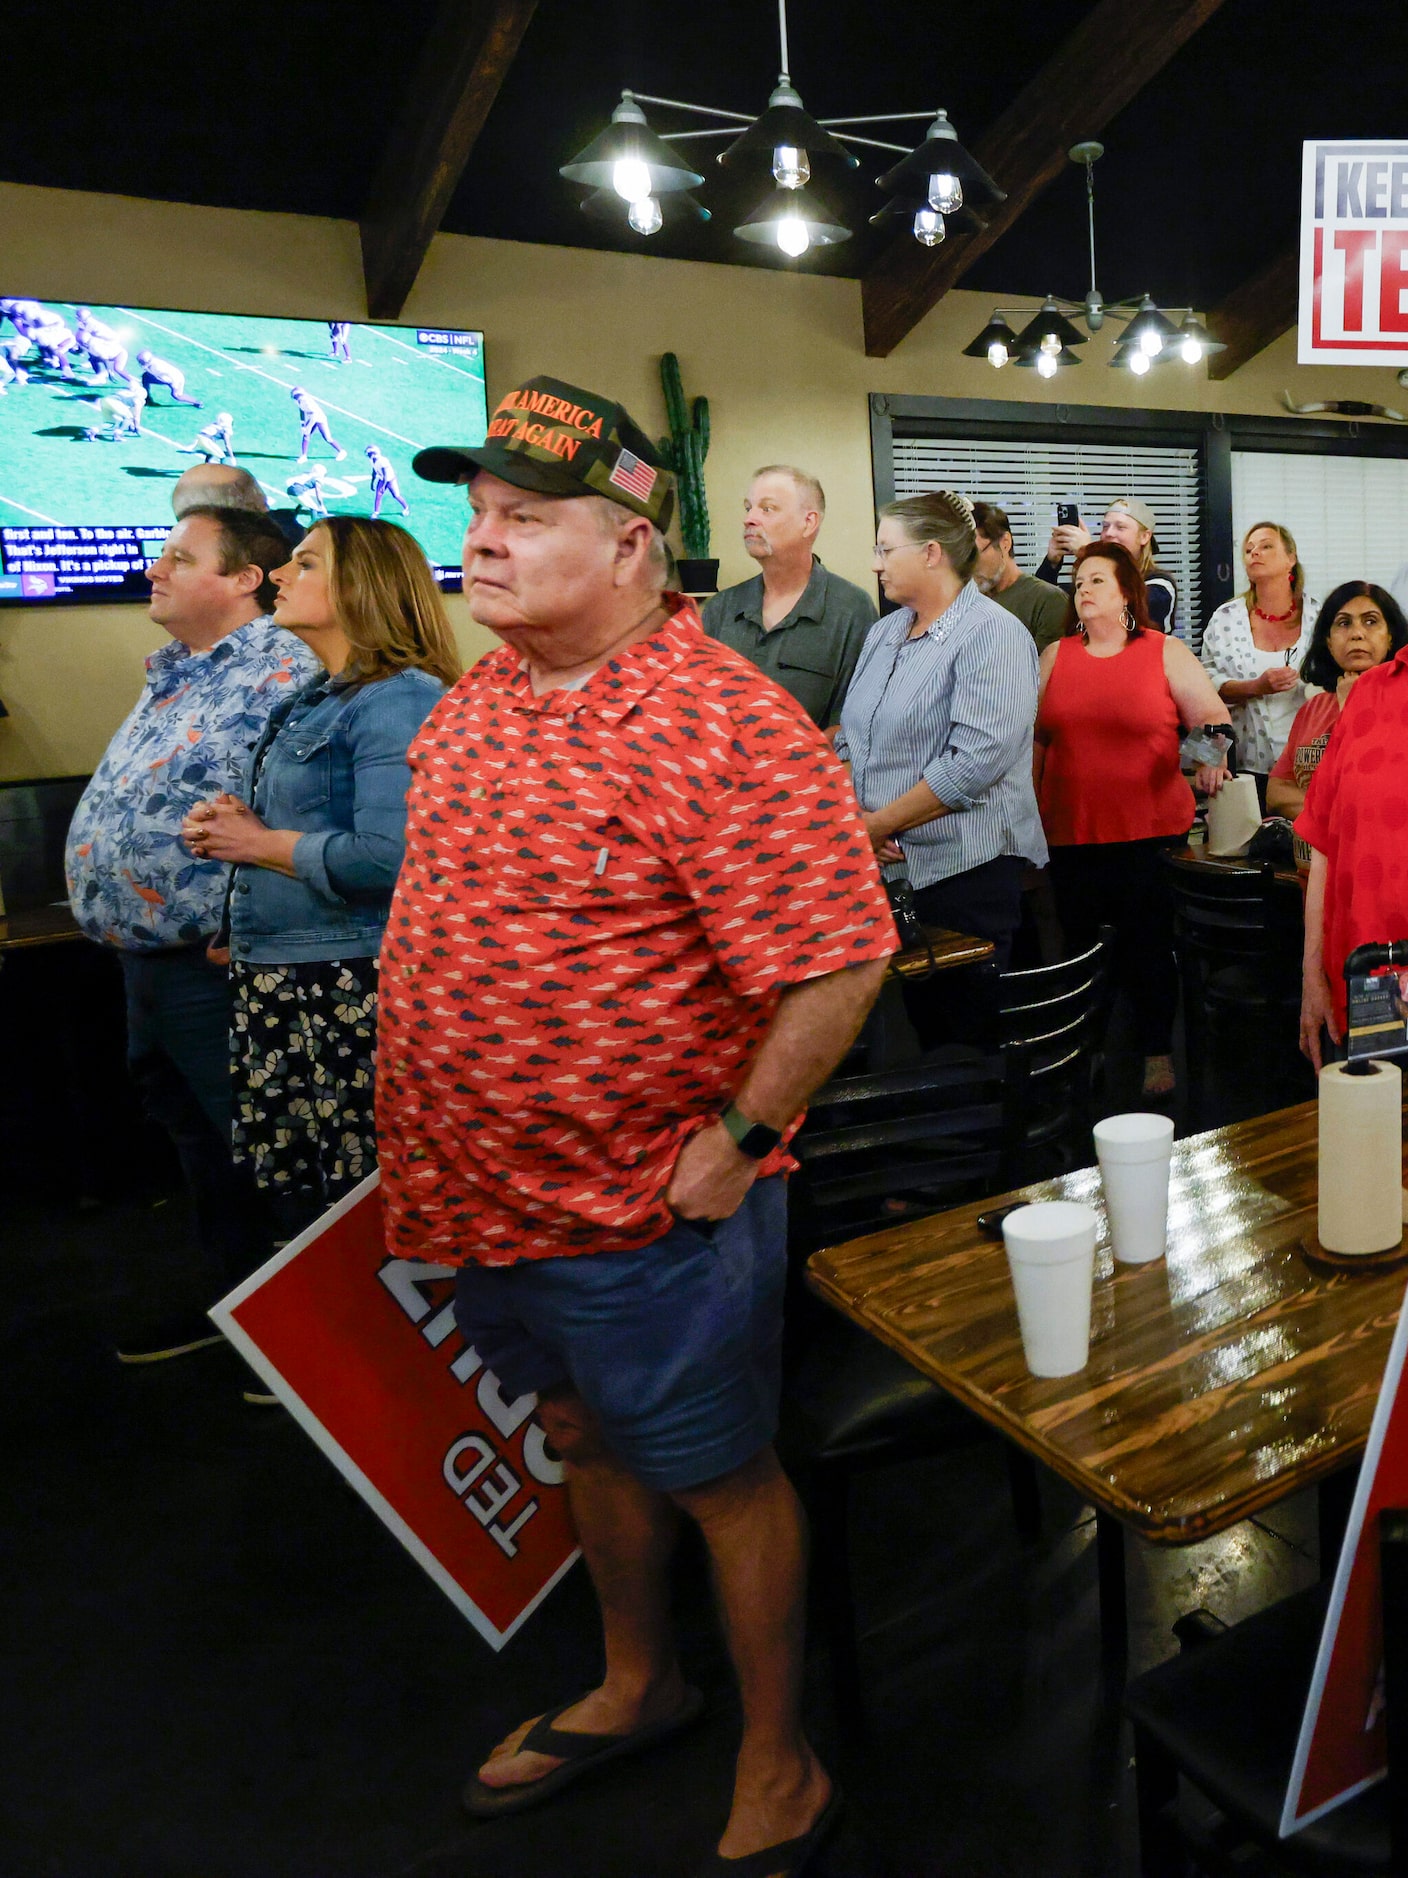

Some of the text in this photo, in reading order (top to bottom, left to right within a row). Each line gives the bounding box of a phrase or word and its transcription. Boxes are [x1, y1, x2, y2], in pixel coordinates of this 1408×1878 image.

[429, 333, 475, 346] CBS NFL
[515, 389, 604, 439] AMERICA
[511, 420, 582, 462] AGAIN
[2, 527, 31, 541] first
[31, 527, 54, 541] and
[55, 527, 79, 540] ten.
[79, 527, 94, 540] To
[94, 527, 115, 540] the
[115, 528, 135, 540] air.
[4, 543, 139, 557] That's Jefferson right in
[6, 560, 22, 573] of
[22, 560, 60, 572] Nixon.
[60, 559, 81, 572] It's
[81, 562, 91, 572] a
[92, 559, 130, 573] pickup
[130, 559, 144, 571] of
[441, 1434, 539, 1559] TED
